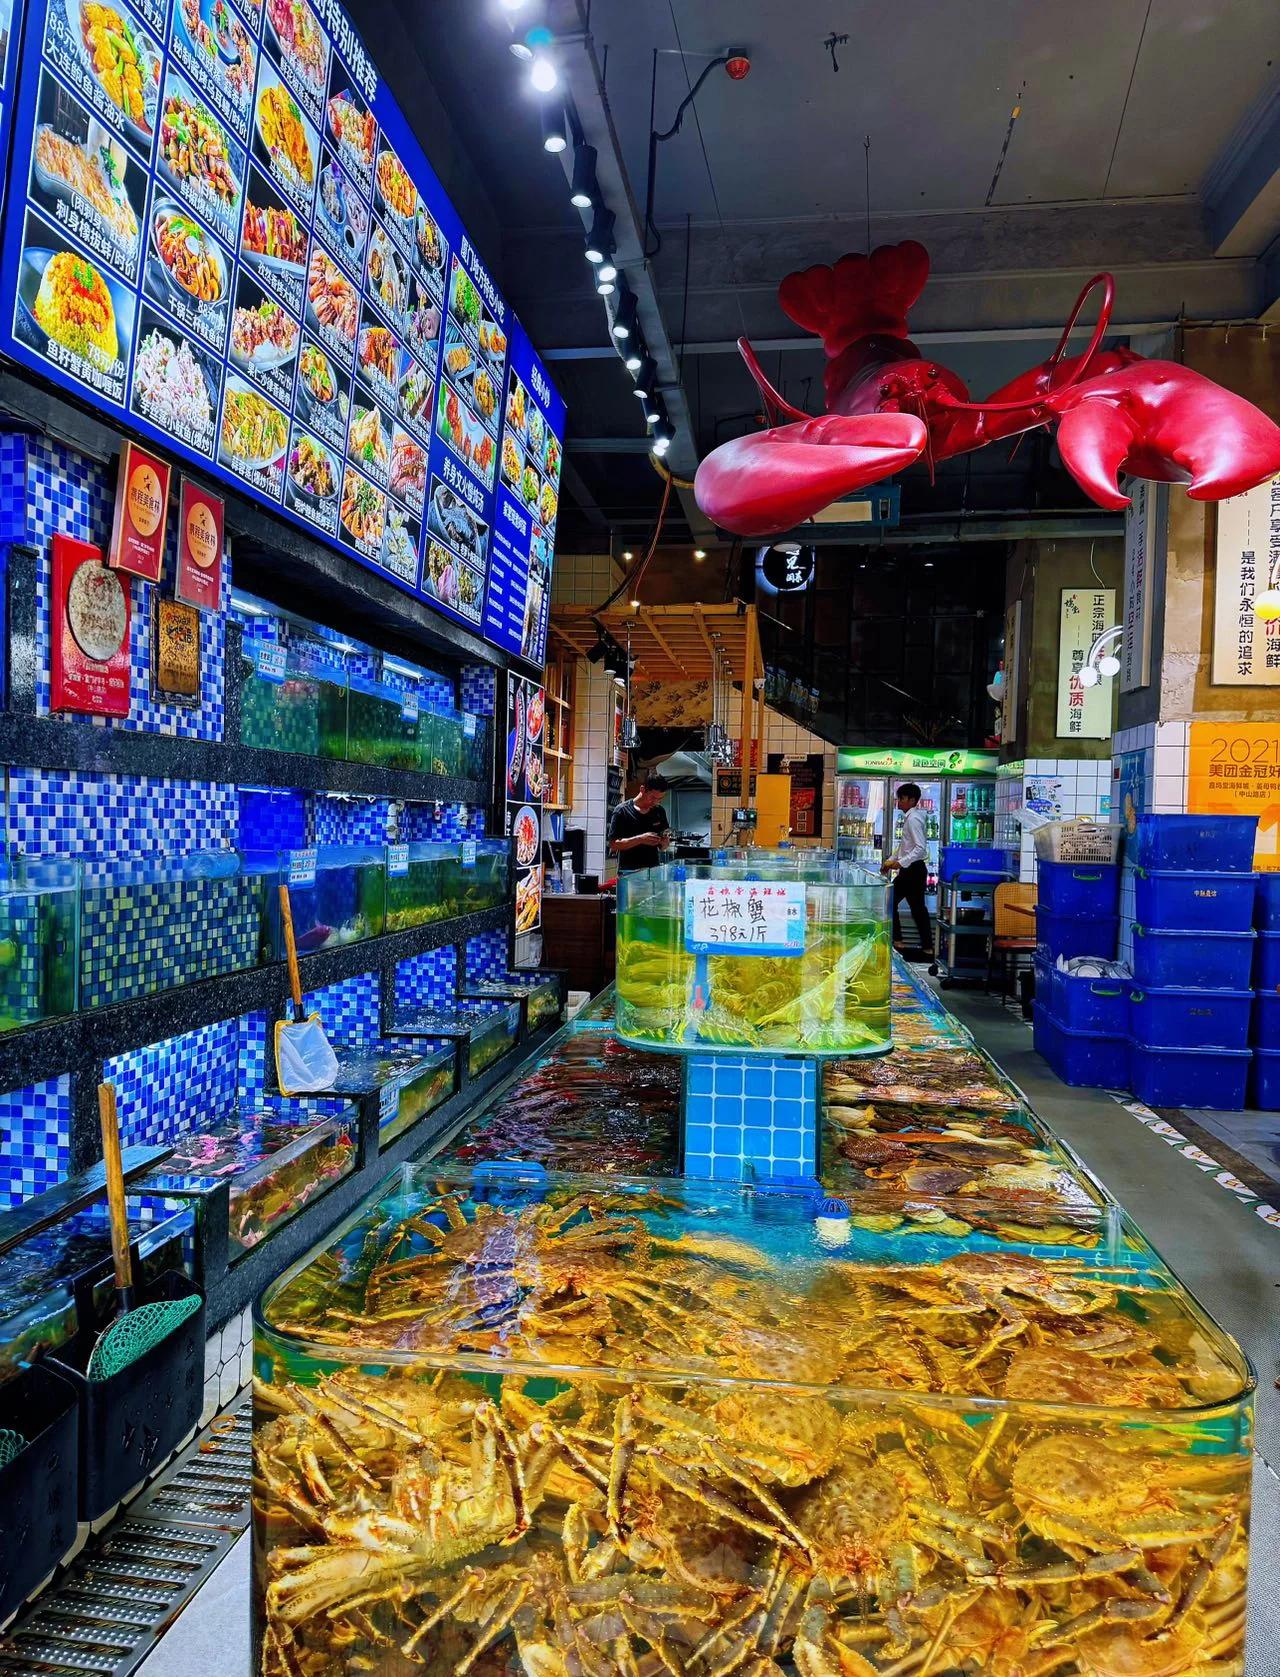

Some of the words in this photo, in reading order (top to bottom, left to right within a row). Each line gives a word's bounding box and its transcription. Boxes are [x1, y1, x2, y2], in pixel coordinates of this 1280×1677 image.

[46, 35, 125, 135] 大连鲍鱼酱油水
[311, 0, 377, 103] 特别推荐
[460, 233, 505, 326] 厦门地方特色小吃
[46, 338, 123, 403] 鱼籽蟹黄咖喱饭
[1237, 550, 1256, 677] 是我们永恒的追求
[1068, 649, 1085, 733] 尊享优质海鲜
[1210, 738, 1280, 763] 2021
[699, 896, 767, 924] 花椒蟹
[710, 925, 768, 943] 398元/斤
